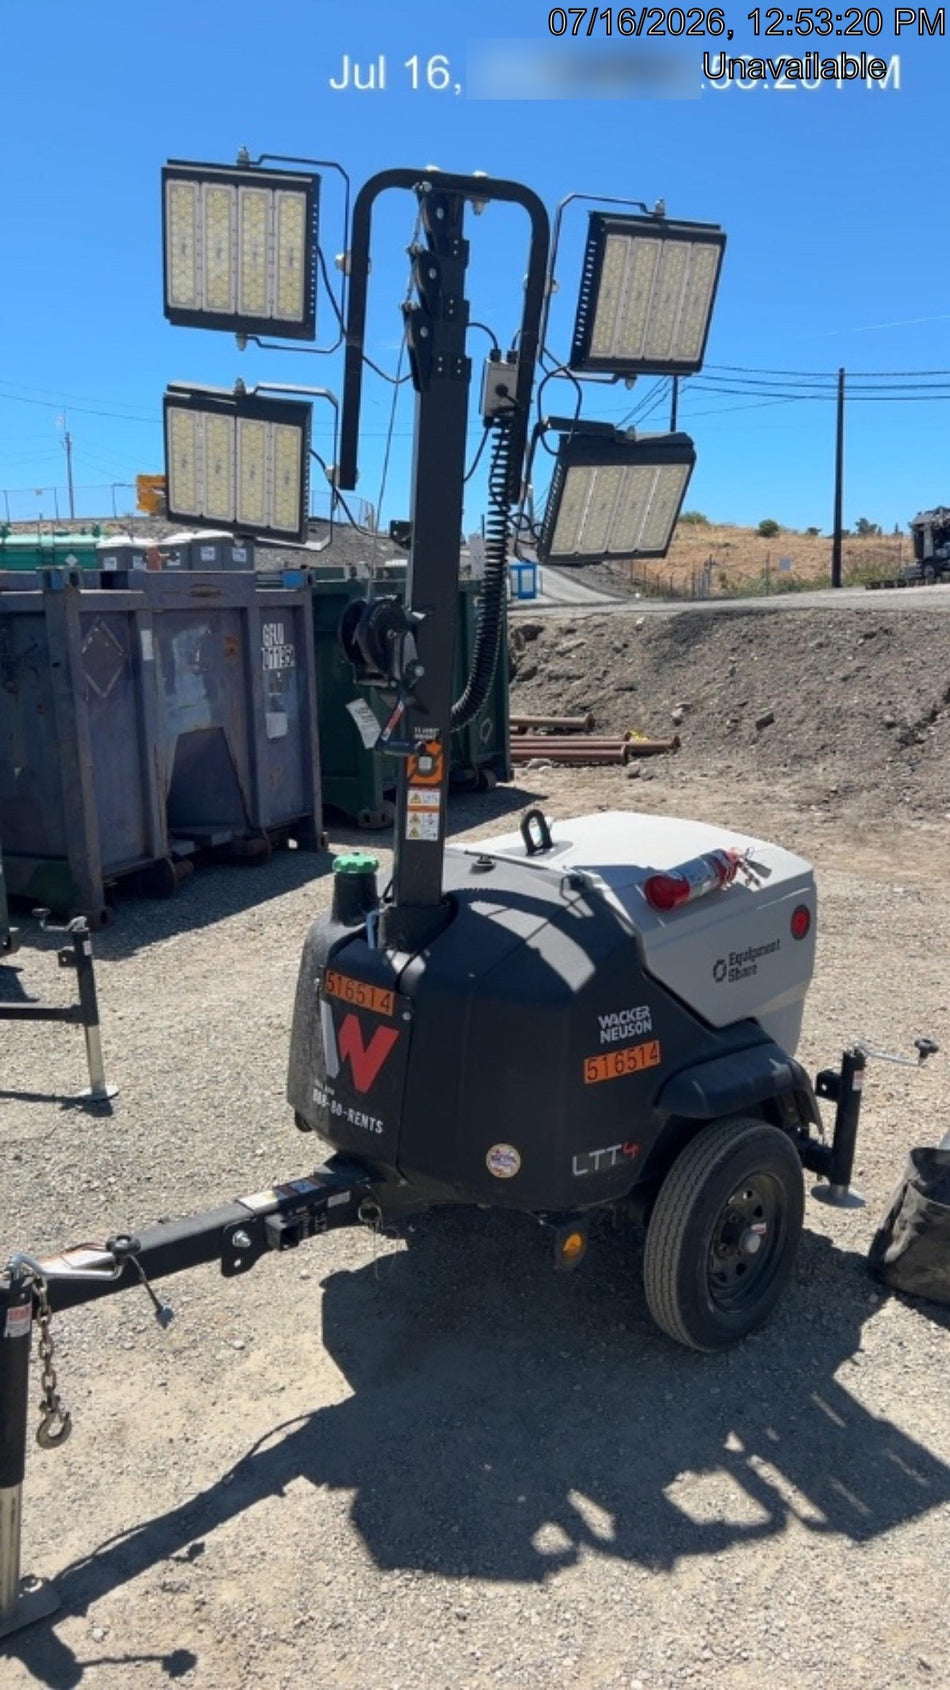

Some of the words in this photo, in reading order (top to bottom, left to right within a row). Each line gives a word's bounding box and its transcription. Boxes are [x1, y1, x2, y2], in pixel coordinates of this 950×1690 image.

[728, 938, 781, 967] Equipment
[728, 963, 758, 983] Share
[326, 972, 392, 1014] 516514
[598, 1005, 650, 1030] WACKER
[599, 1018, 653, 1044] NEUSON
[586, 1043, 660, 1081] 516514
[572, 1142, 640, 1176] LTT4
